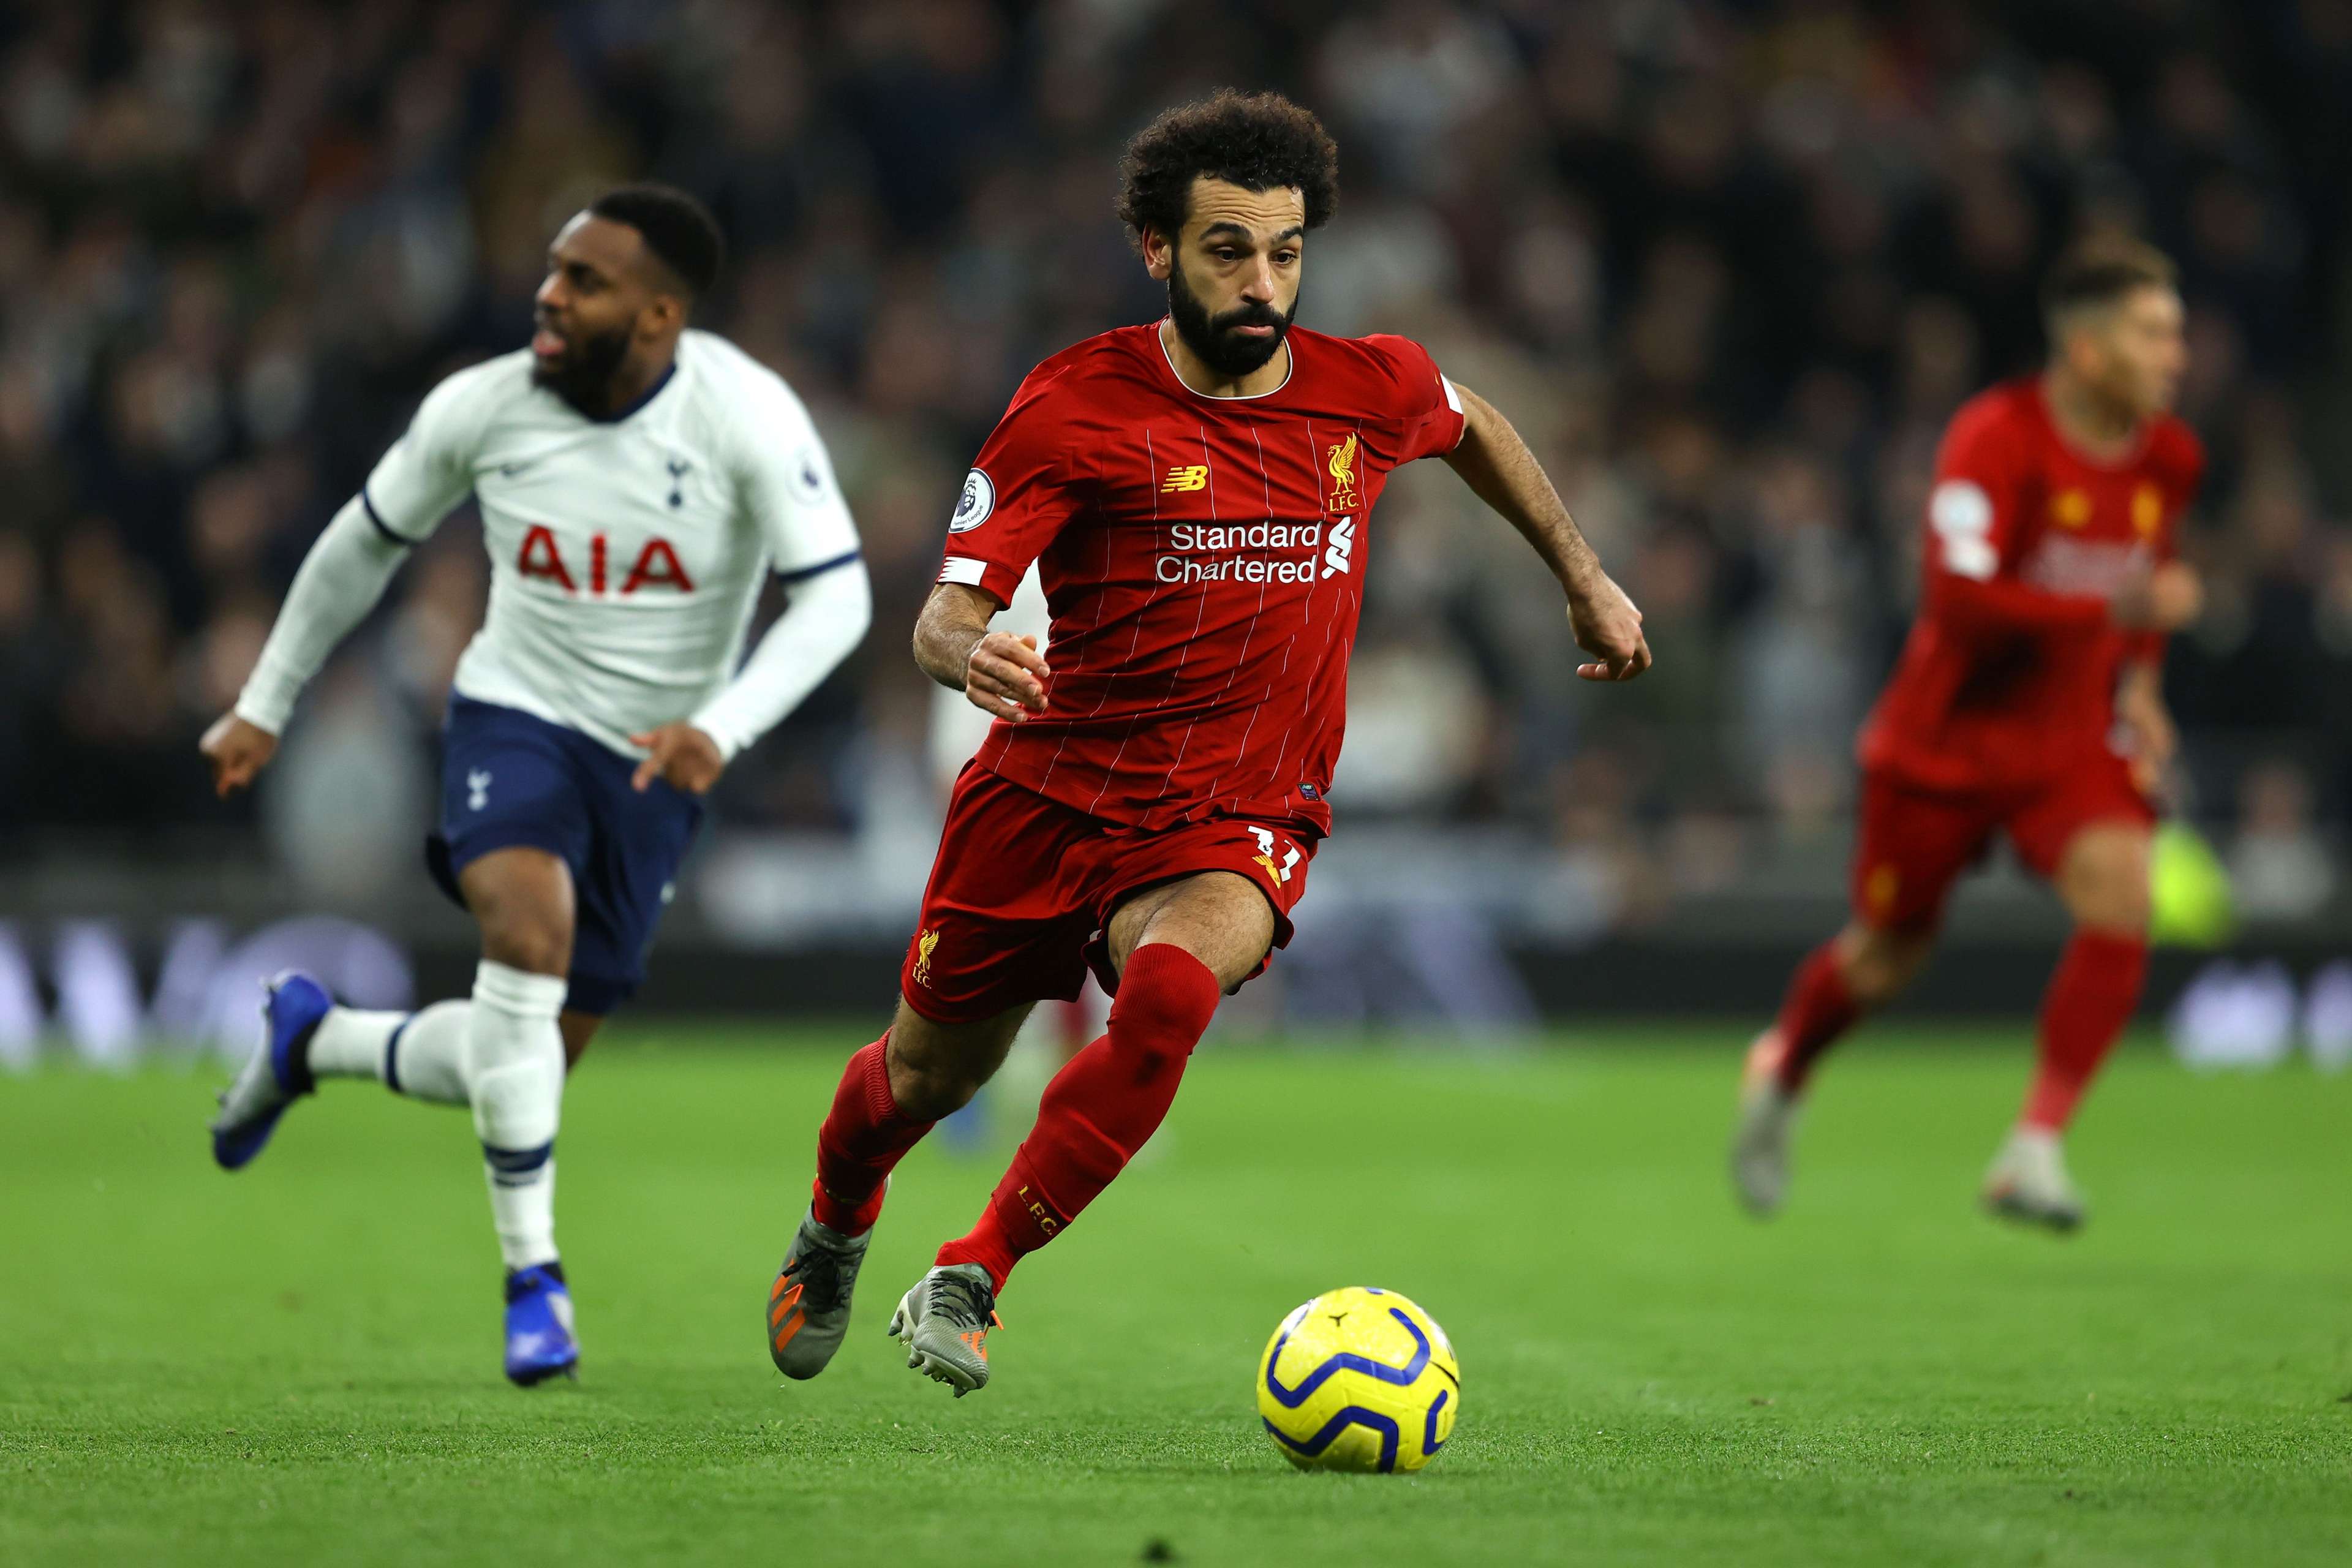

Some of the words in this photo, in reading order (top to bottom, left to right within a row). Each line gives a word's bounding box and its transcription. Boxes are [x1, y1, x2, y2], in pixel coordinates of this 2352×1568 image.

[967, 505, 984, 522] League
[1170, 520, 1323, 551] Standard
[517, 524, 695, 594] AIA
[1156, 554, 1317, 584] Chartered
